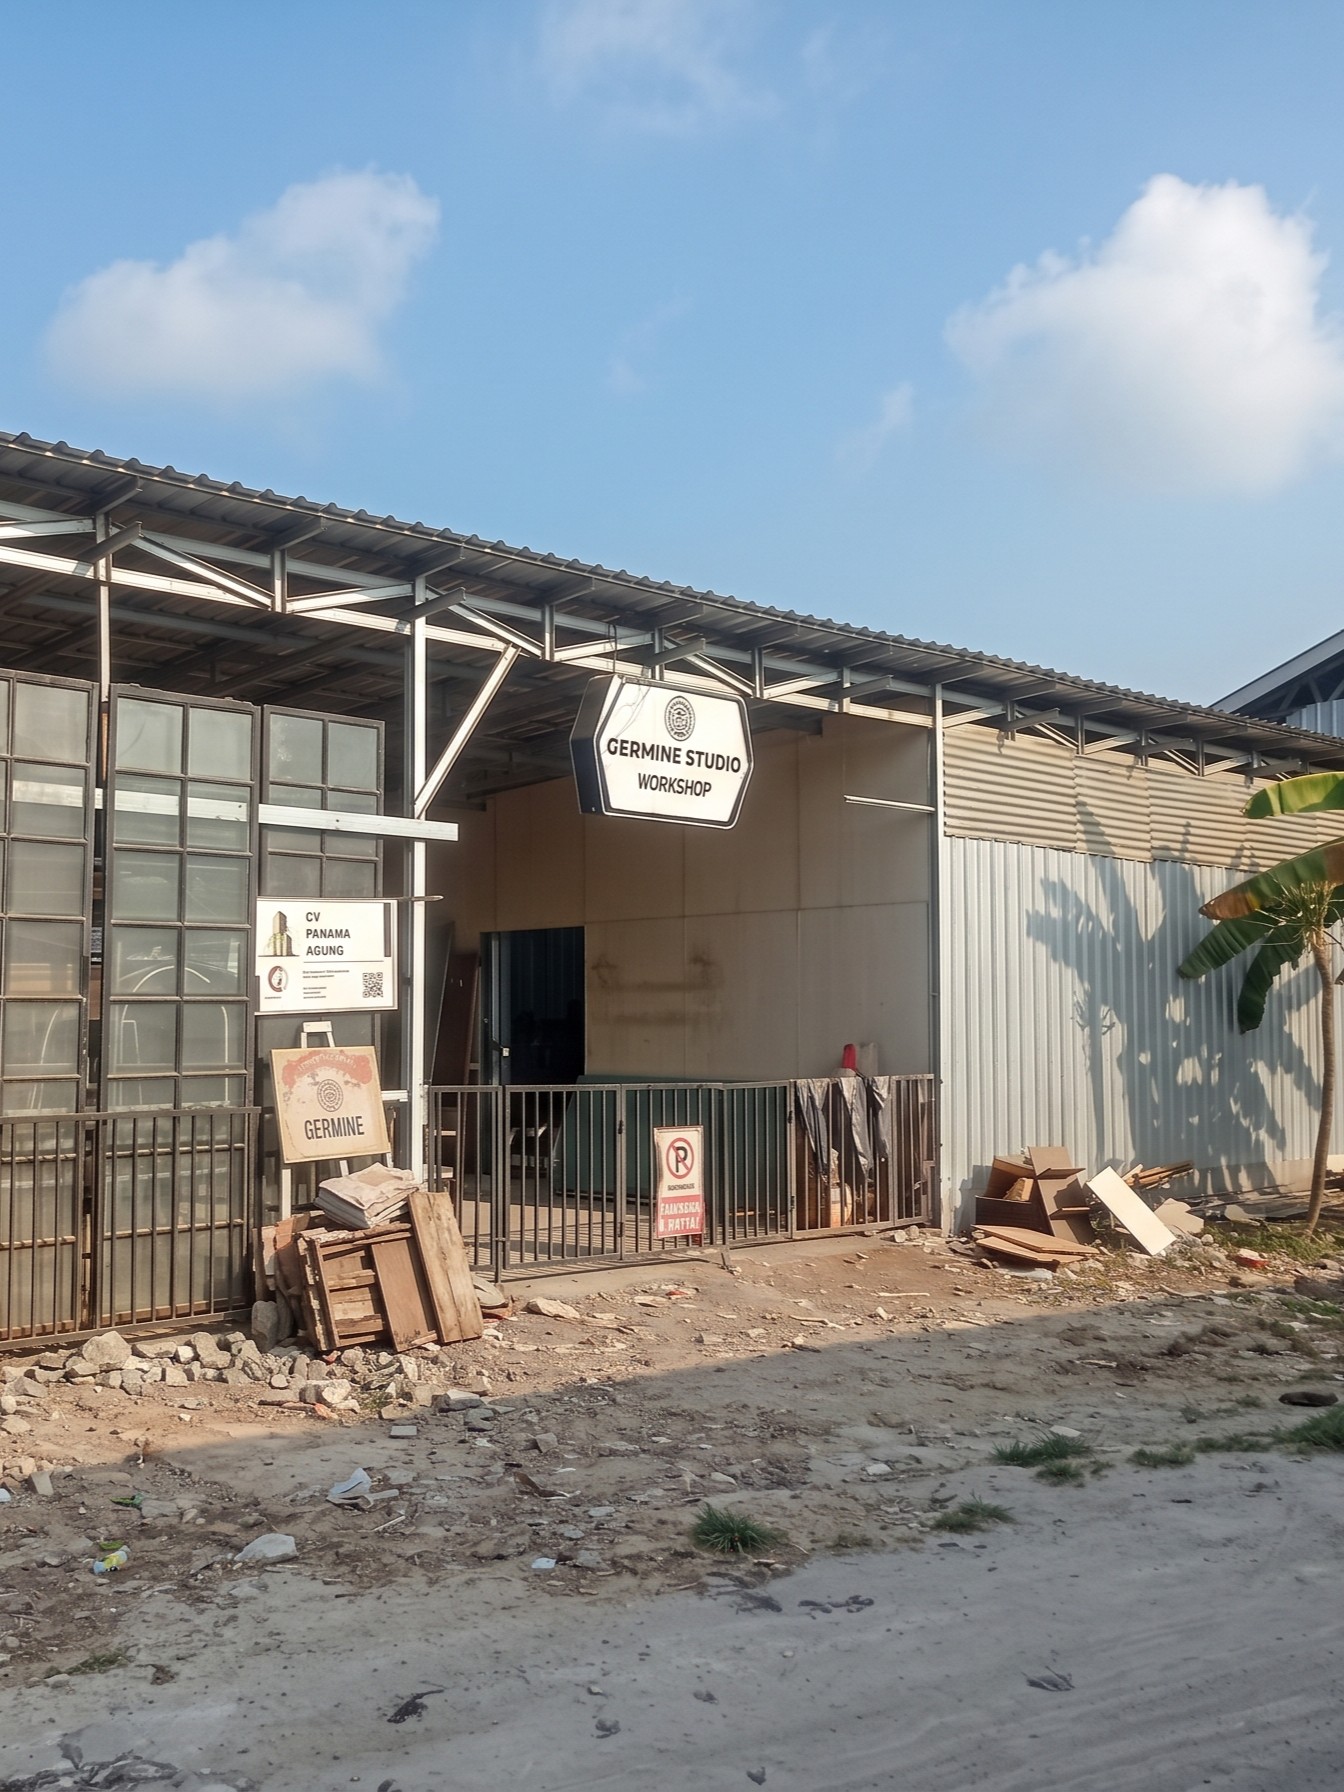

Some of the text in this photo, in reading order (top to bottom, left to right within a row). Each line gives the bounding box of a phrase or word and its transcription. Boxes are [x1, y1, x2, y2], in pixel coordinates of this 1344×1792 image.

[607, 737, 741, 773] GERMINE STUDIO
[638, 772, 712, 797] WORKSHOP
[305, 911, 321, 922] CV
[305, 928, 351, 939] PANAMA
[305, 945, 344, 956] AGUNG
[304, 1115, 365, 1140] GERMINE
